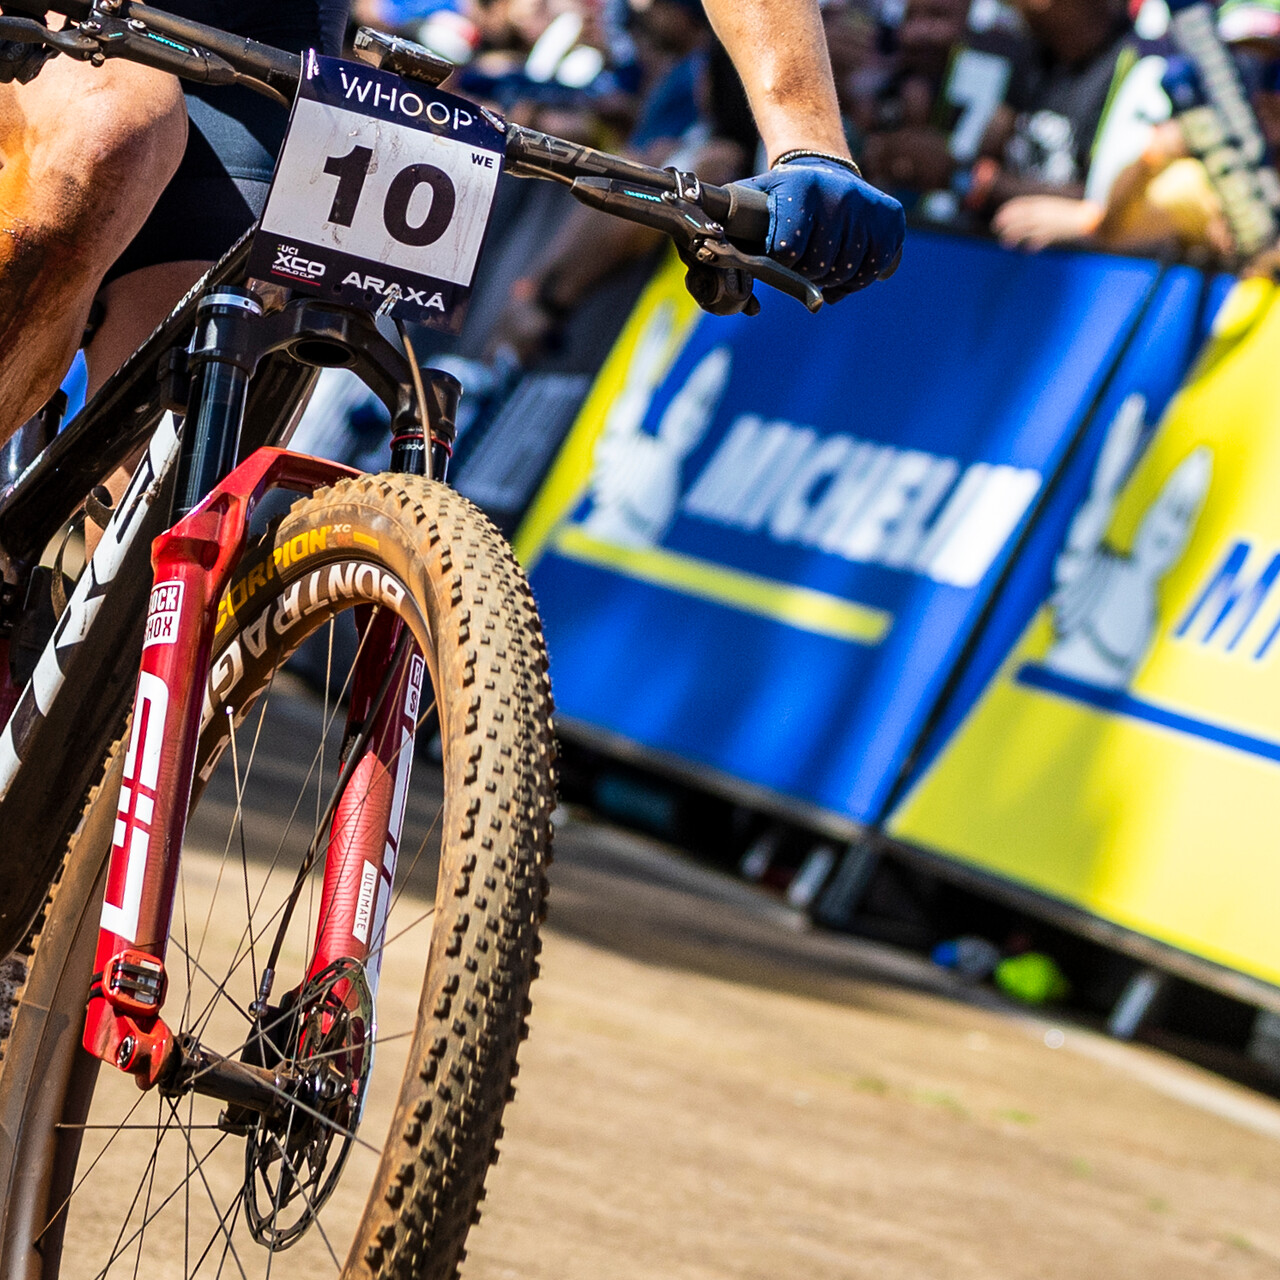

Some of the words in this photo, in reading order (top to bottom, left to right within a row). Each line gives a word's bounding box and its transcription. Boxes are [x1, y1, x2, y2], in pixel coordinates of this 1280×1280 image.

[339, 67, 473, 130] WHOOP
[471, 153, 494, 169] WE
[323, 145, 456, 247] 10
[281, 244, 299, 255] UCI
[273, 251, 326, 277] XCO
[342, 271, 446, 312] ARAXÁ
[332, 523, 352, 534] XC
[215, 526, 327, 636] CORPION
[149, 586, 178, 614] OCK
[144, 615, 173, 641] HOX
[355, 871, 374, 931] ULTIMATE
